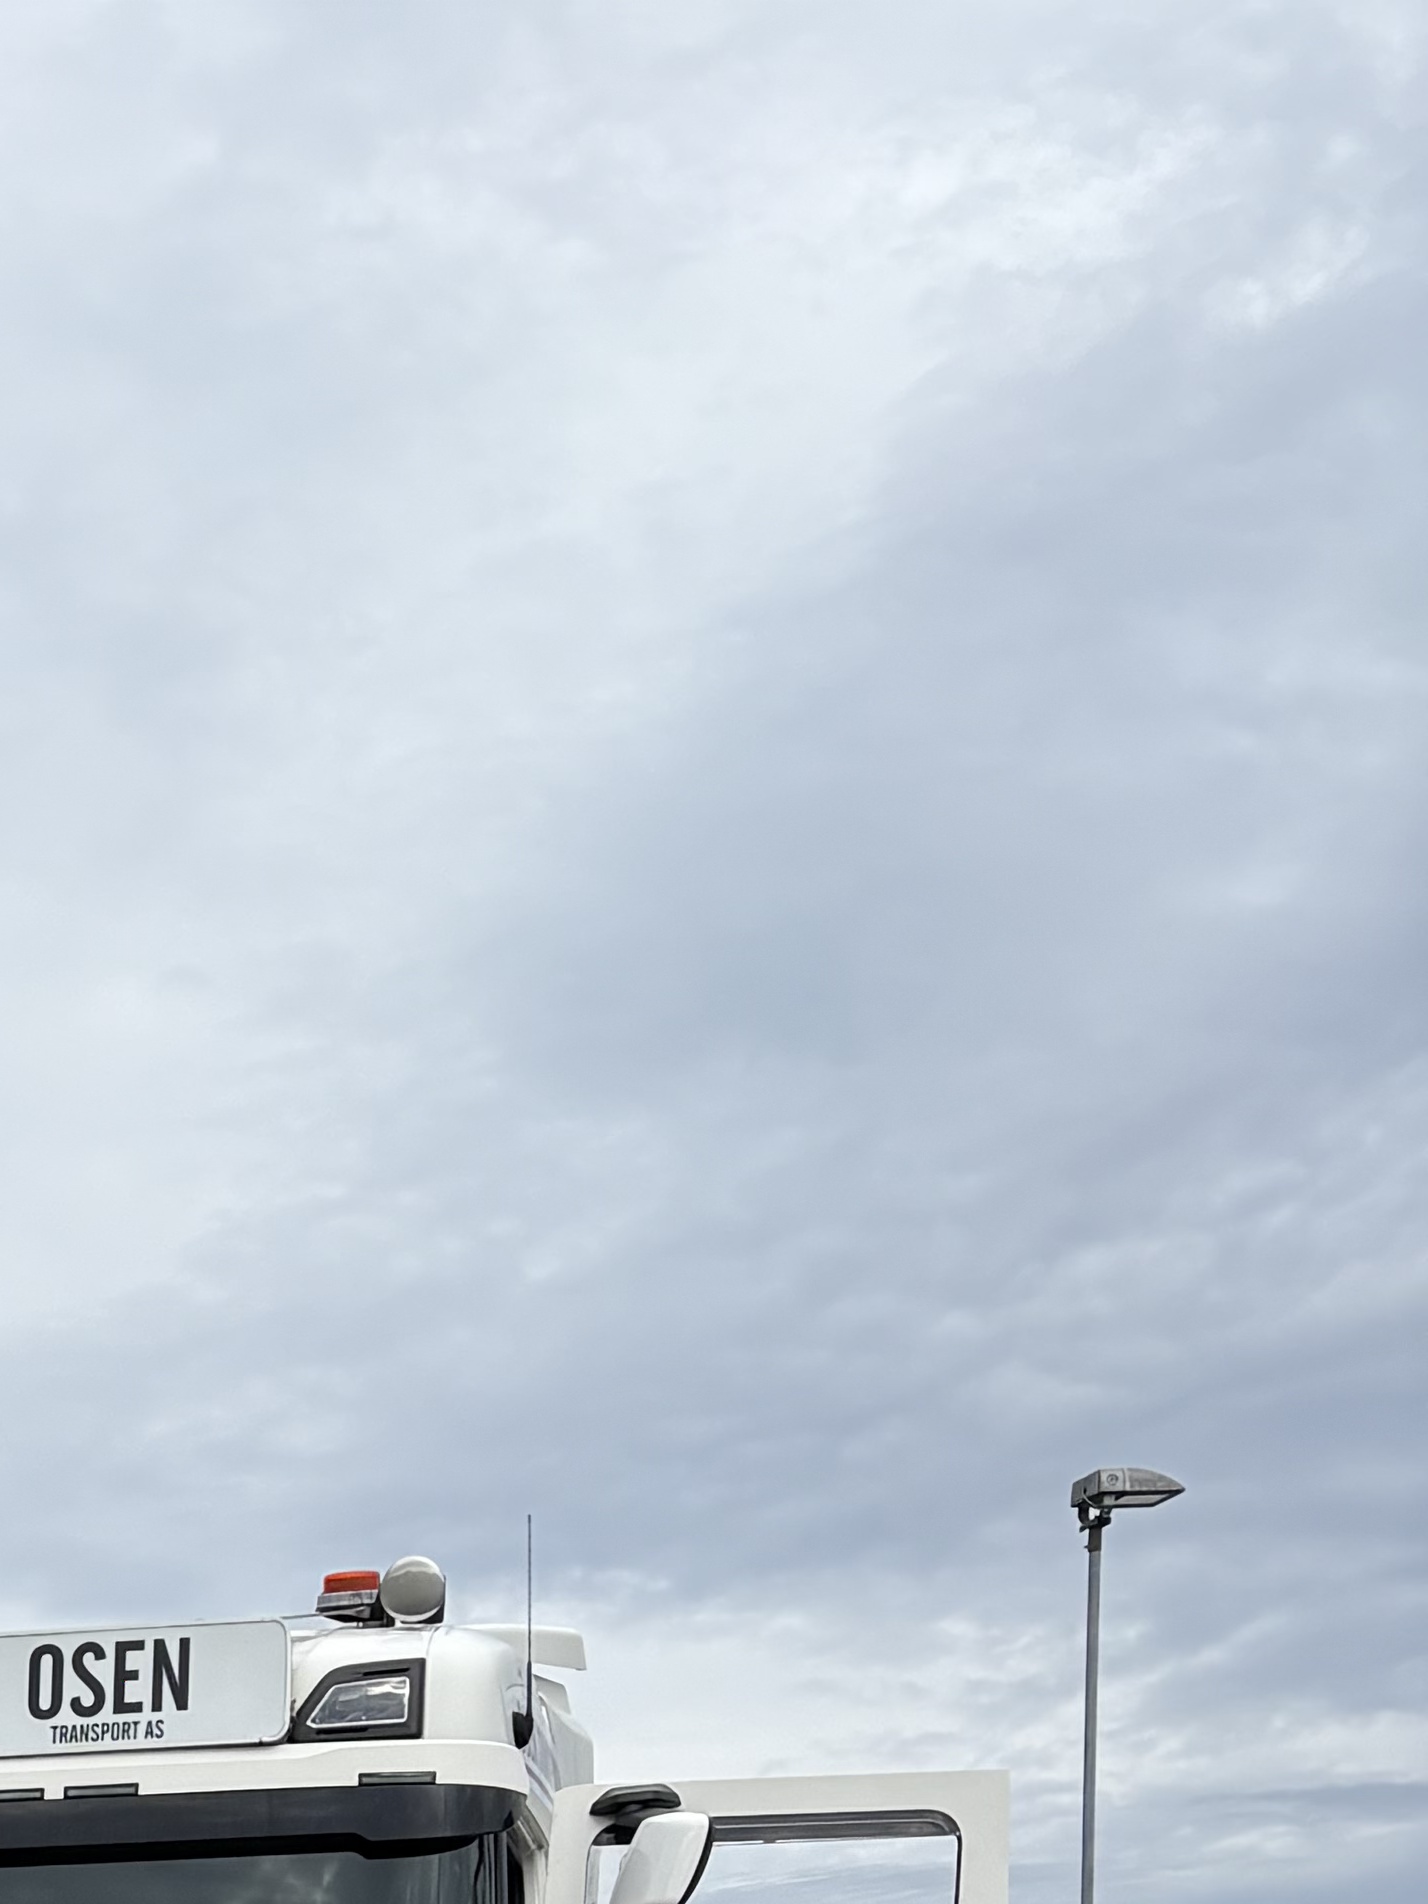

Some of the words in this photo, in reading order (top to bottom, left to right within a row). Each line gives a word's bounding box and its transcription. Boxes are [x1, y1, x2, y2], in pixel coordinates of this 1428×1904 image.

[28, 1637, 191, 1720] OSEN
[50, 1721, 141, 1744] TRANSPORT
[144, 1719, 165, 1740] AS
